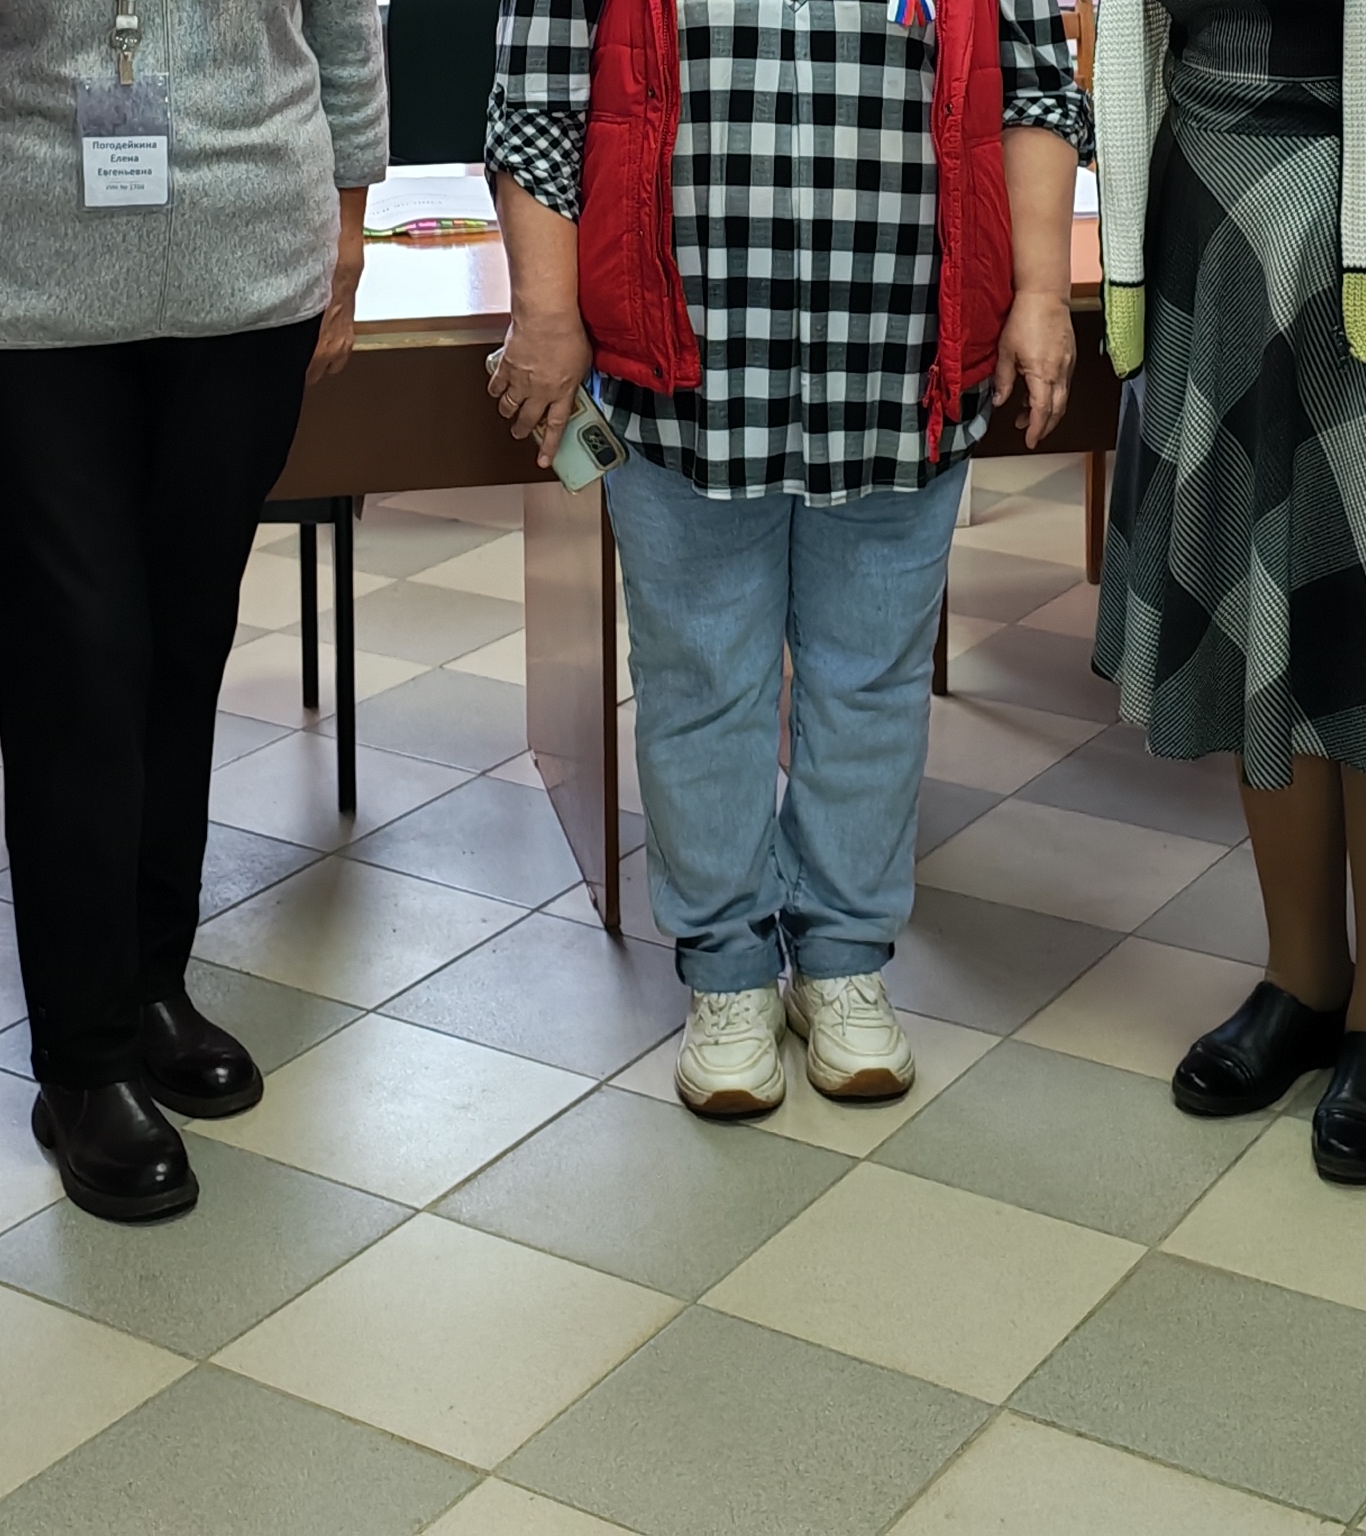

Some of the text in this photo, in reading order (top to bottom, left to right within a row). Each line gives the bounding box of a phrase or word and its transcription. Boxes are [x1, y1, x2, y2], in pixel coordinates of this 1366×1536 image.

[92, 140, 157, 150] Погодейкина
[110, 154, 139, 162] Елена
[97, 168, 152, 176] Евгеньевна
